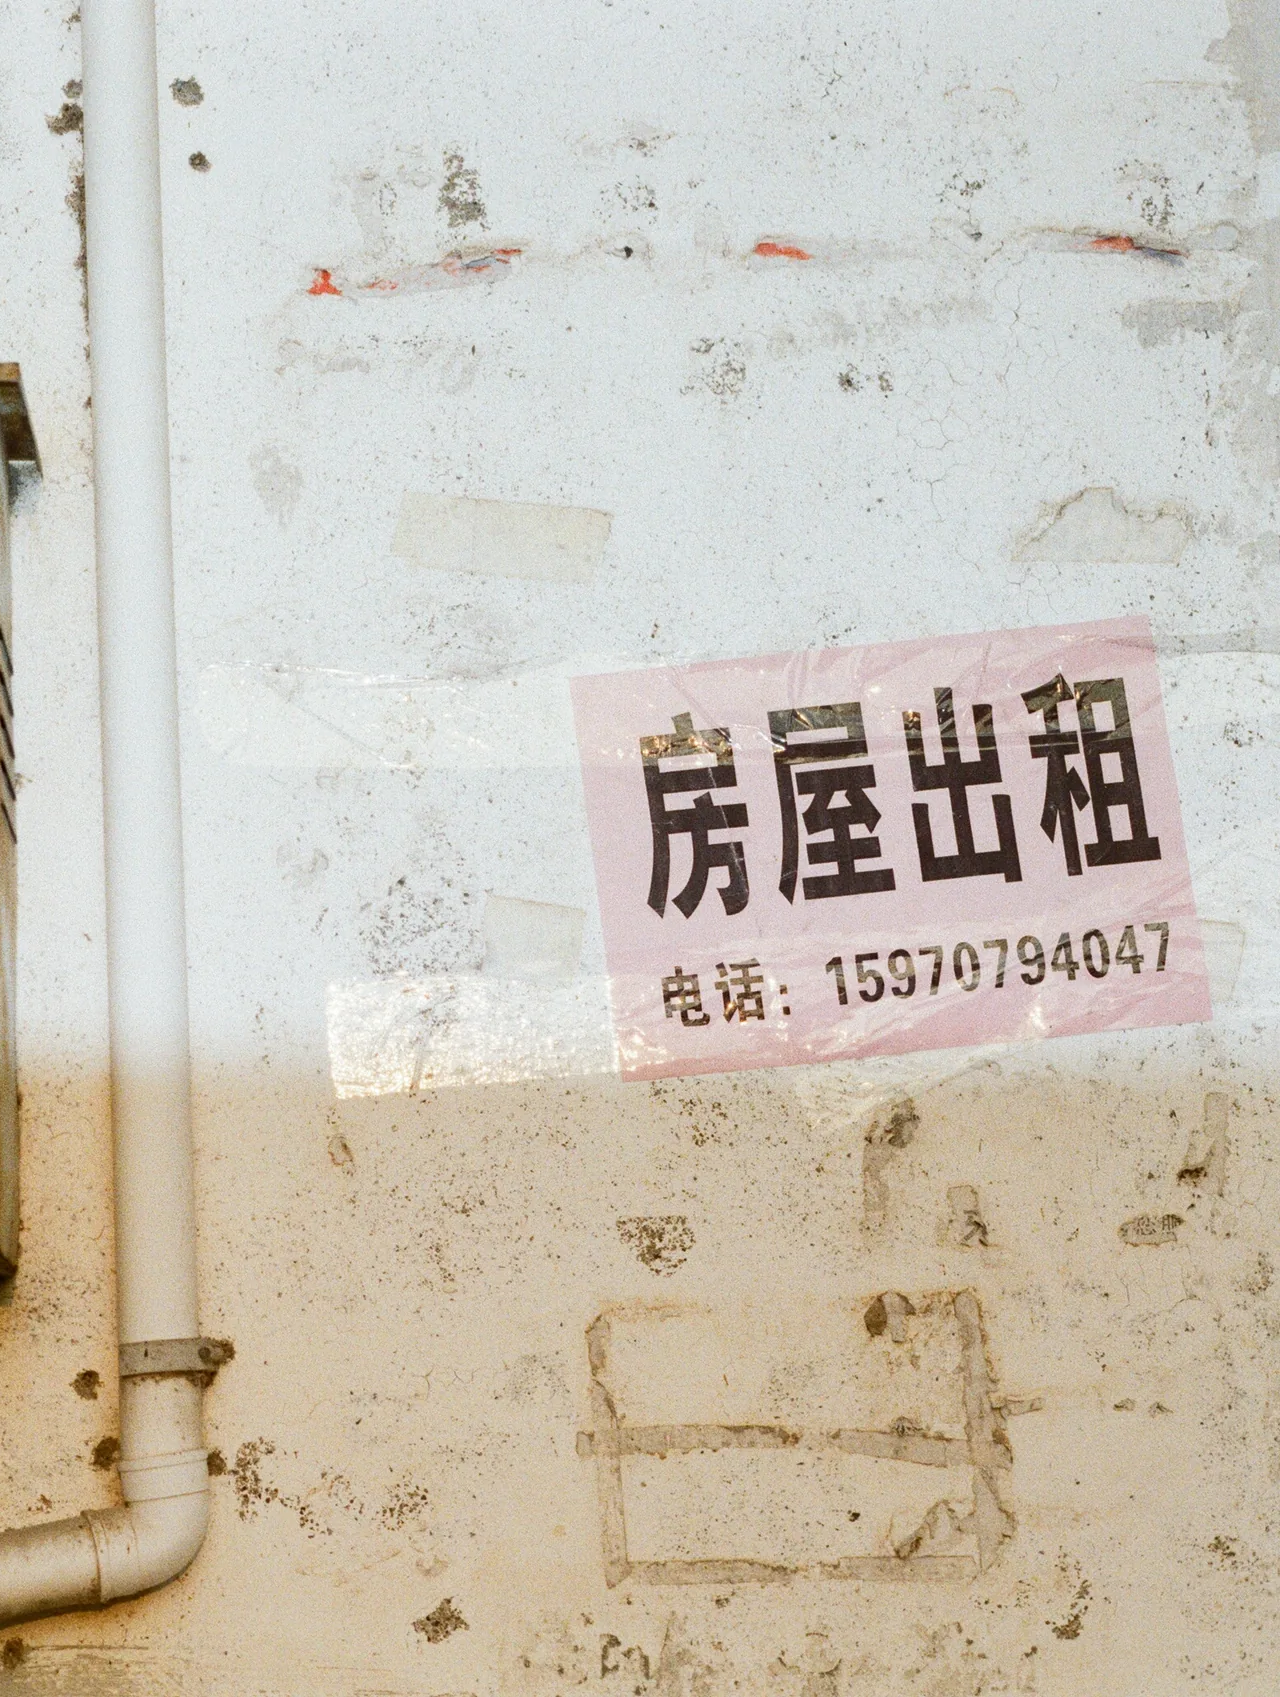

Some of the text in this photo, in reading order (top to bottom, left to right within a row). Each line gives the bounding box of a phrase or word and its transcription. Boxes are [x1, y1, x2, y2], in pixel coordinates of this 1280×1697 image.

[639, 673, 1162, 919] 房屋出租
[825, 921, 1170, 1005] 15970794047
